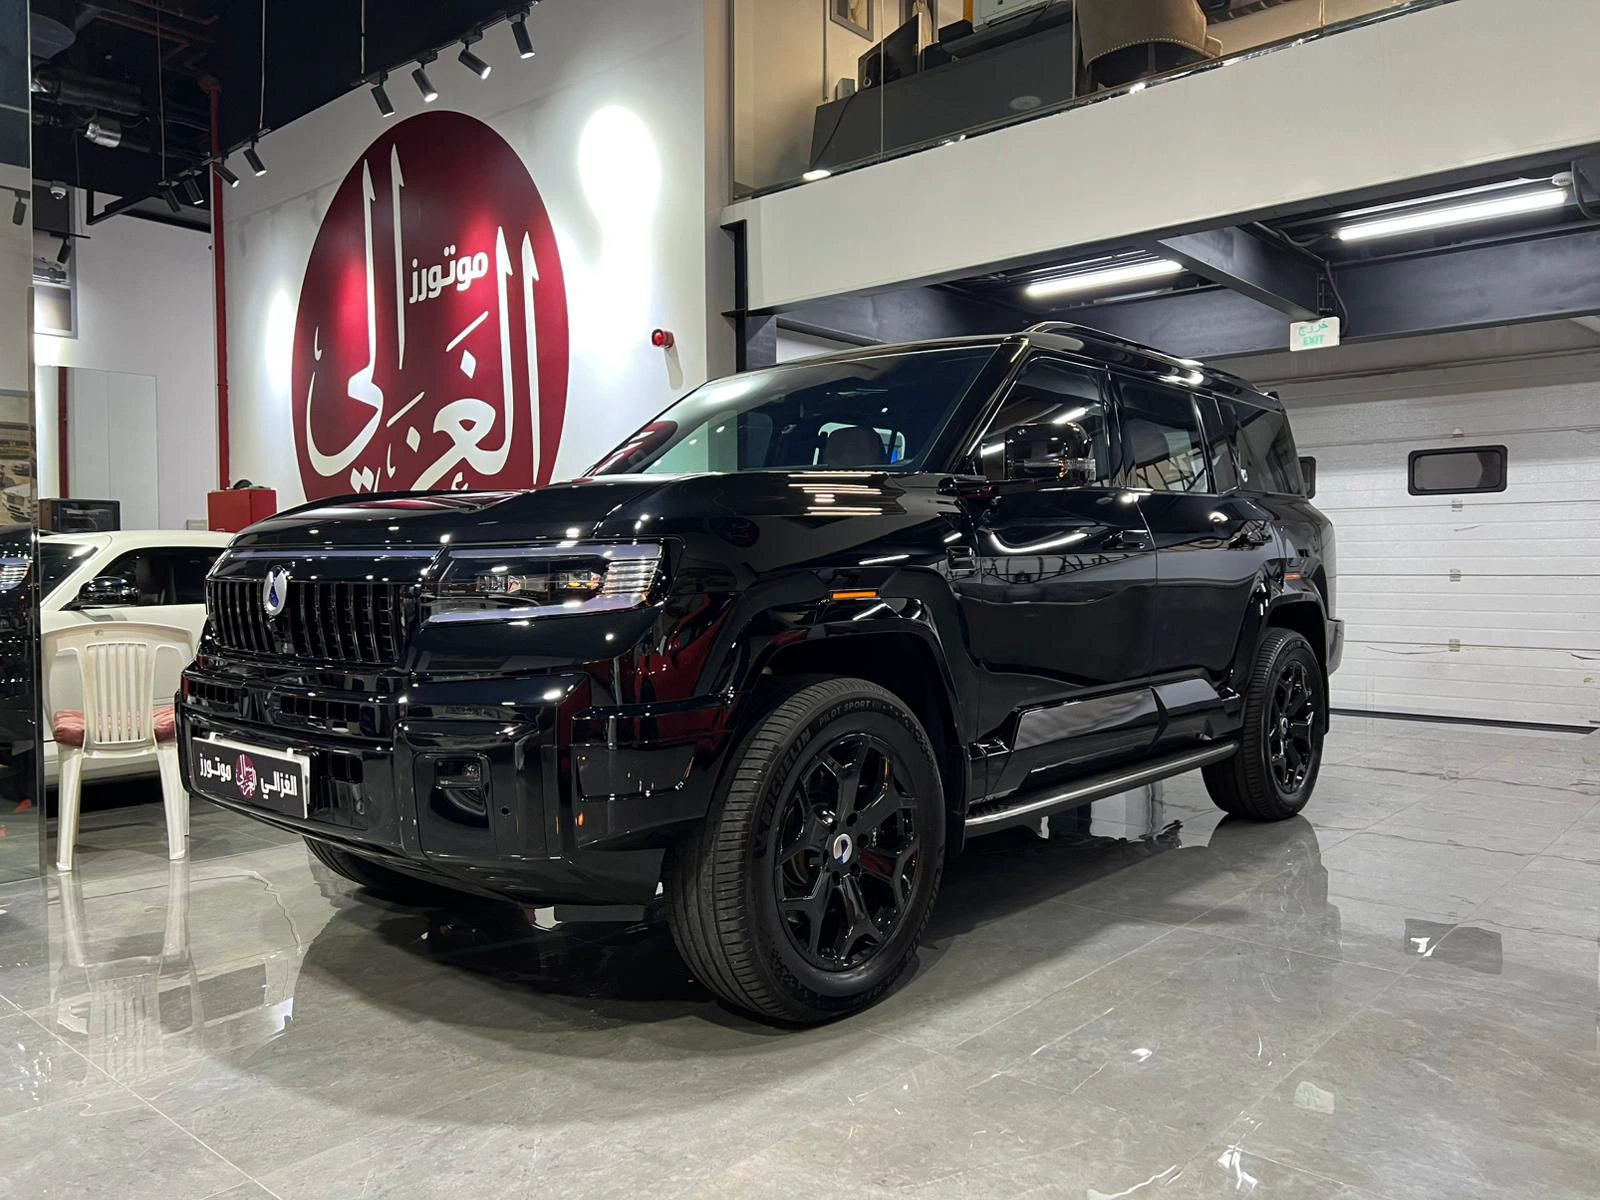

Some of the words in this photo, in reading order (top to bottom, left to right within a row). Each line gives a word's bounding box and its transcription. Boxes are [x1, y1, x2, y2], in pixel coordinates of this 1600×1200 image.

[409, 244, 489, 304] موتورز
[1303, 335, 1325, 346] EXIT
[200, 752, 232, 782] موتورز
[760, 727, 811, 825] MICHELIN
[818, 706, 841, 728] PILOT
[843, 700, 871, 711] SPORT
[260, 770, 298, 799] الغزالي
